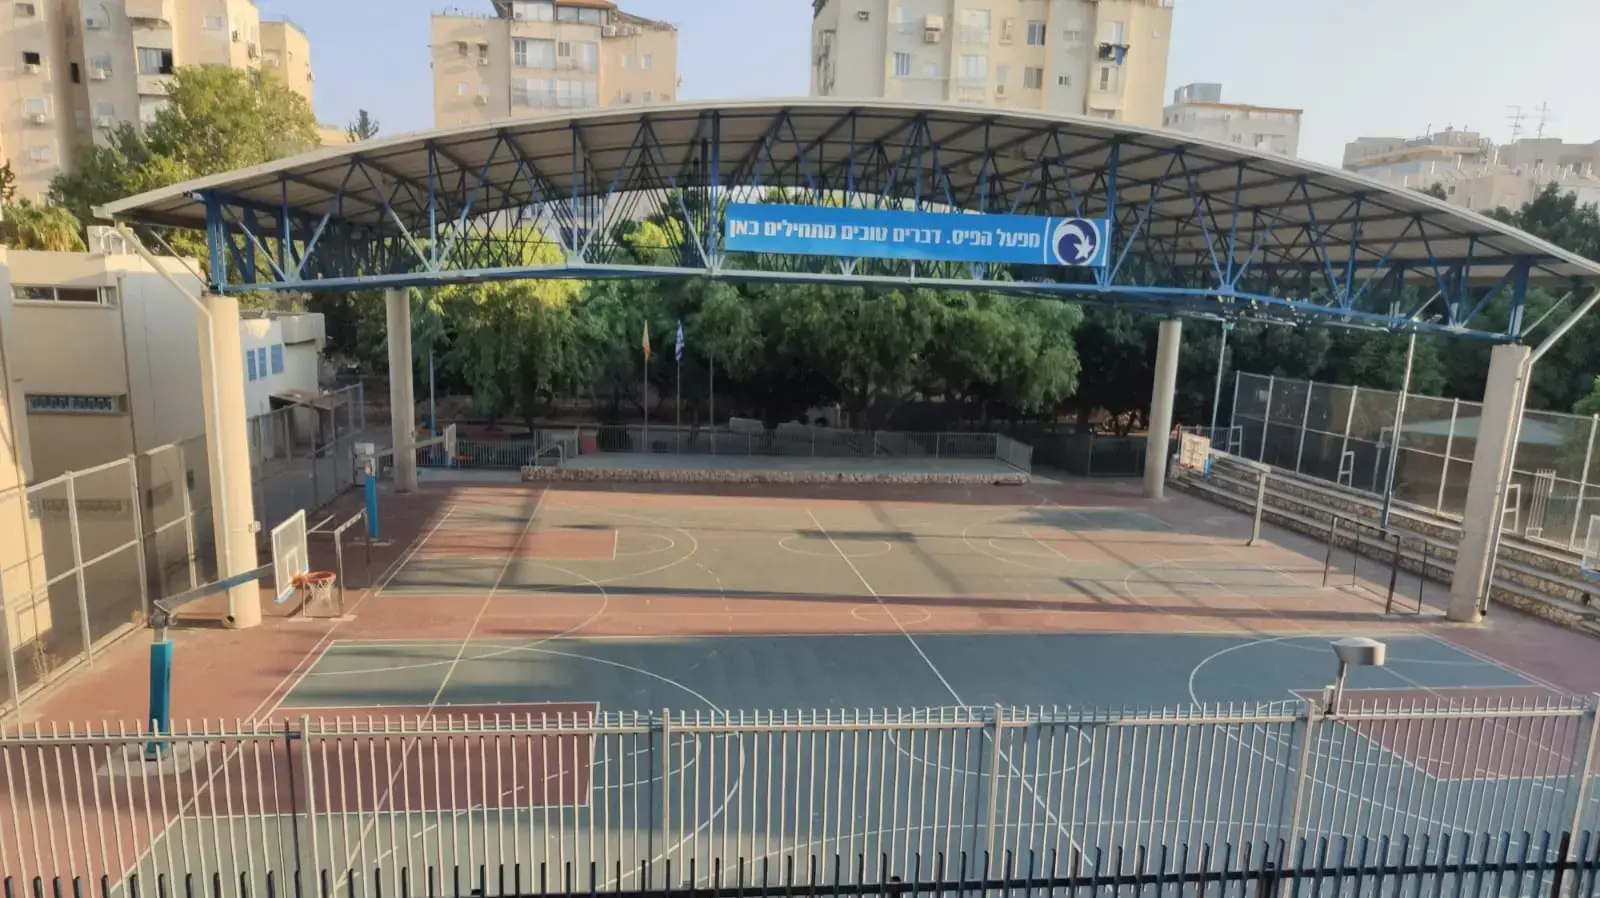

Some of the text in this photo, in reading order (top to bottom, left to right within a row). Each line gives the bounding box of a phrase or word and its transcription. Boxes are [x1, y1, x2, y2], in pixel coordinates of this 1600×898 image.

[730, 219, 1040, 248] מפעל הפיס. דברים טובים מתחילים כאן
